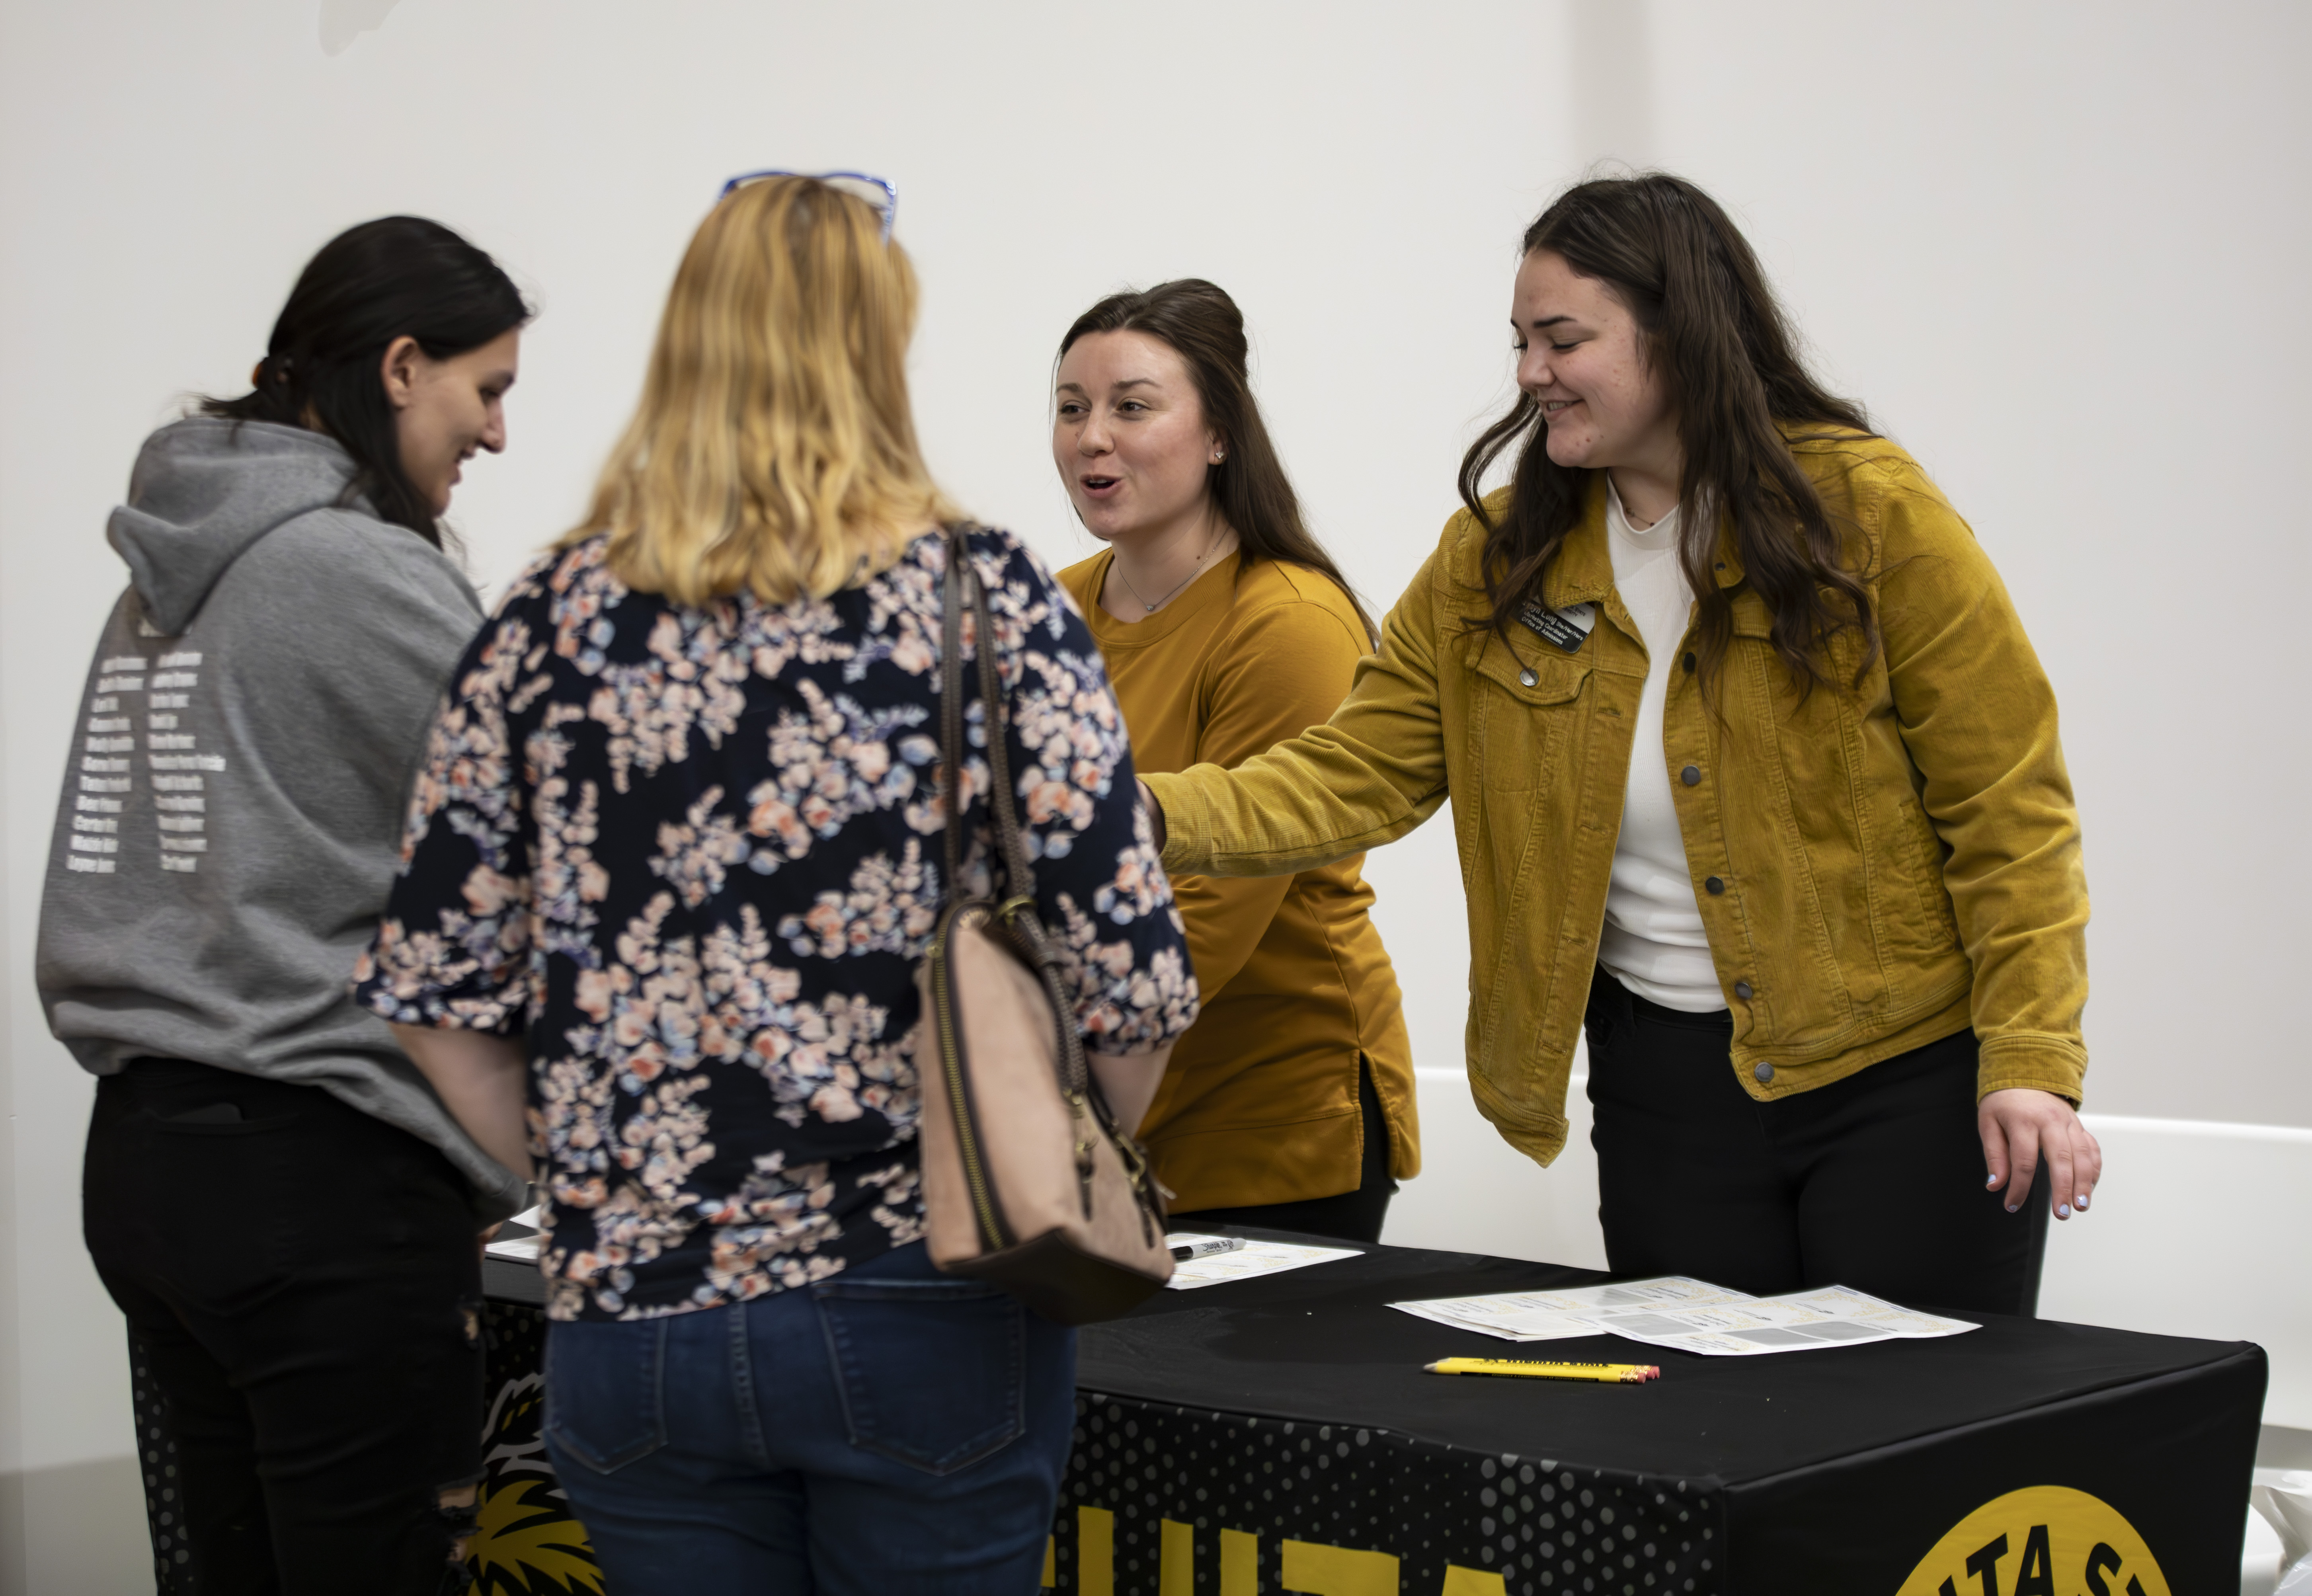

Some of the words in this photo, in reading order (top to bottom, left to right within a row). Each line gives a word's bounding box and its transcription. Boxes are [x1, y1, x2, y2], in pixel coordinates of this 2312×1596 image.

[1522, 617, 1535, 627] Office
[1541, 629, 1563, 645] Admissions
[1541, 611, 1557, 625] Long
[1556, 621, 1583, 641] She/Her/Hers
[1545, 623, 1568, 640] Coordinator
